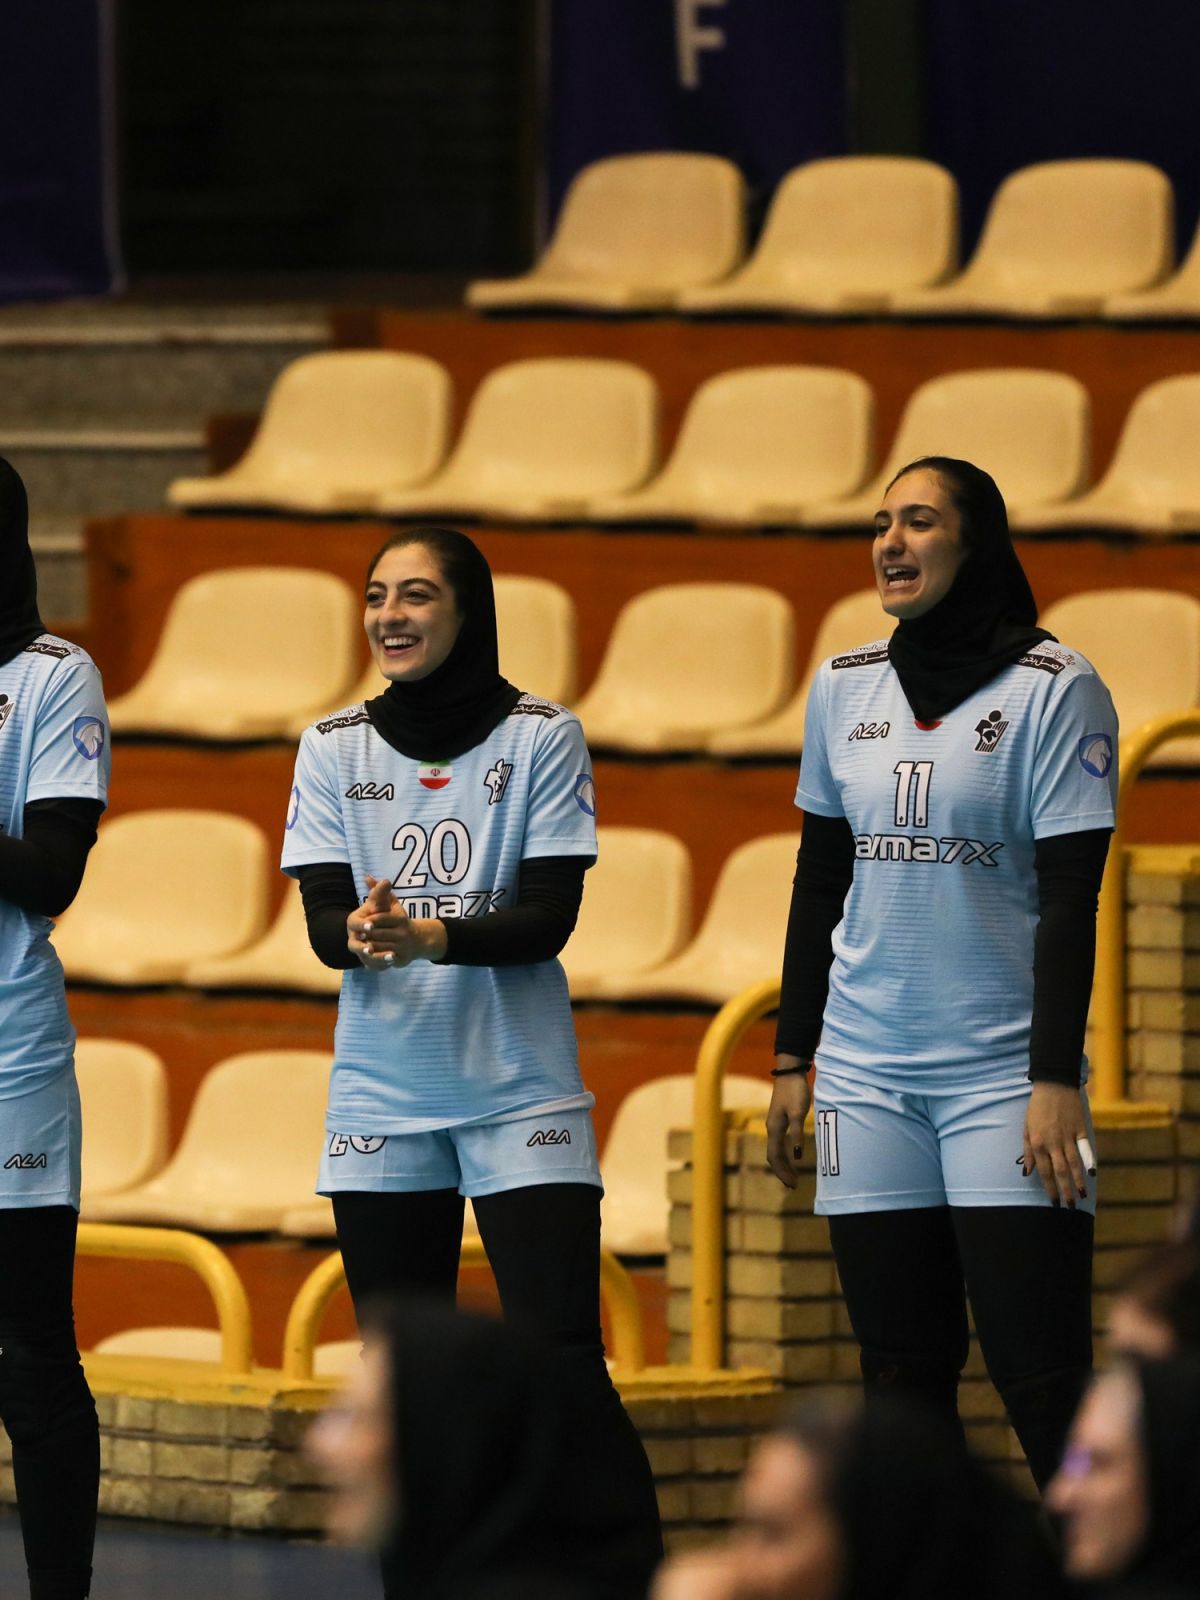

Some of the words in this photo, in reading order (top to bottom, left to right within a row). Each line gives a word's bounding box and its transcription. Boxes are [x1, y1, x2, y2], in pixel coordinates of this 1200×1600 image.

[893, 760, 934, 828] 11
[391, 818, 472, 889] 20
[818, 1110, 840, 1176] 11
